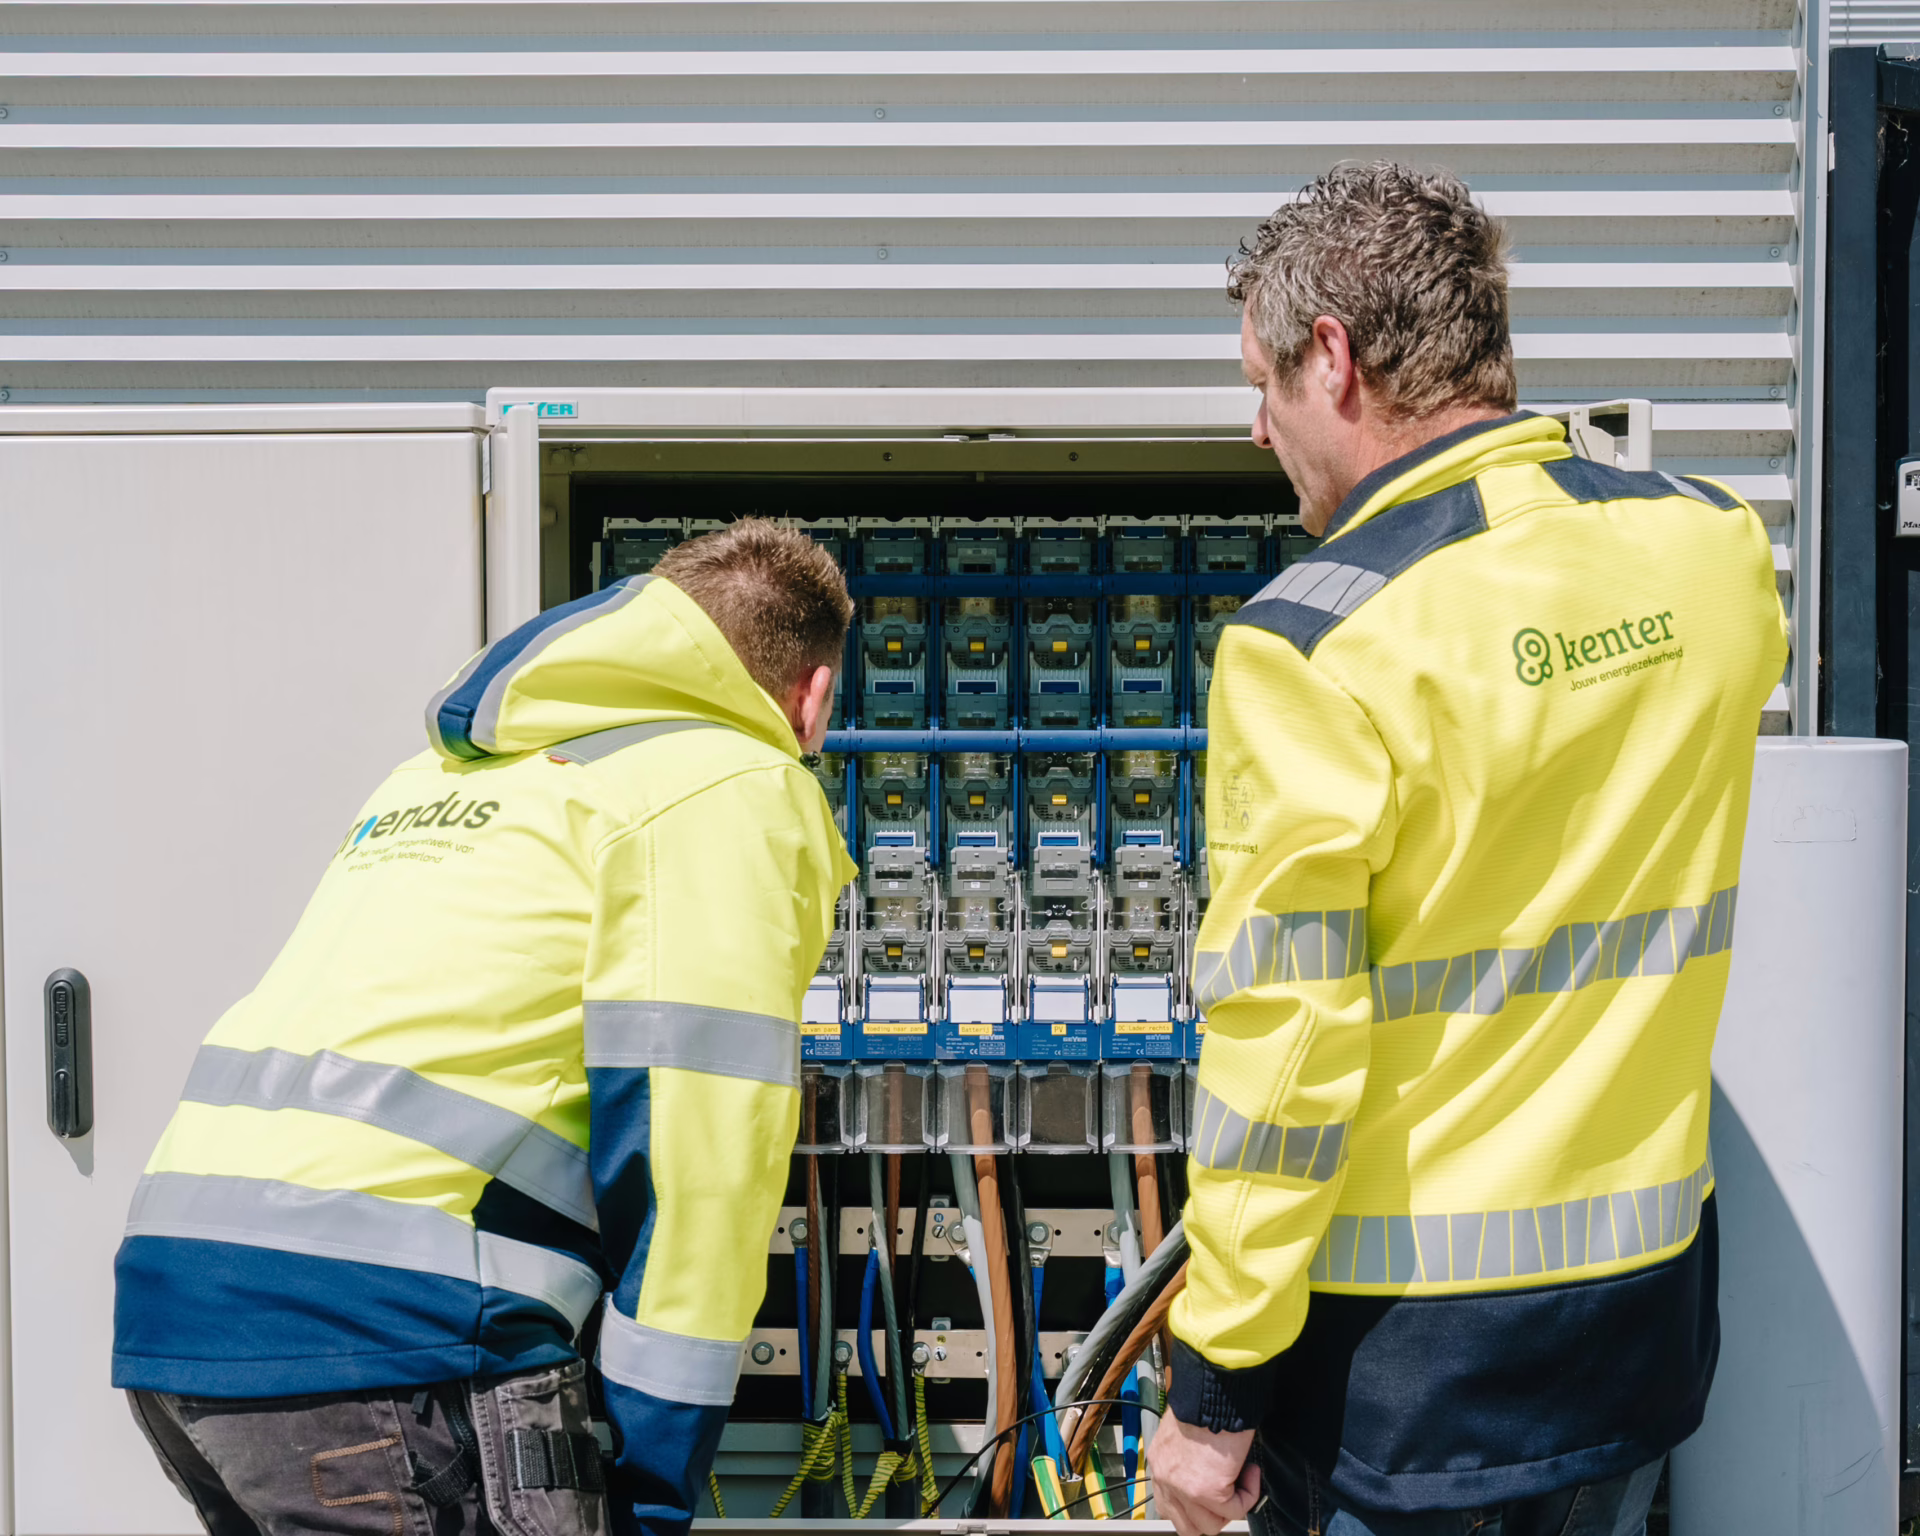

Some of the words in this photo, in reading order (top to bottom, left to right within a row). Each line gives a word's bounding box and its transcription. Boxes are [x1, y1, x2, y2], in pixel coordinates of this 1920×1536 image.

[503, 402, 574, 417] YER
[1555, 611, 1674, 672] kenter
[1570, 674, 1598, 691] Jouw
[1599, 646, 1684, 683] energiezekerheid
[455, 843, 475, 855] van
[1054, 1025, 1064, 1033] PV
